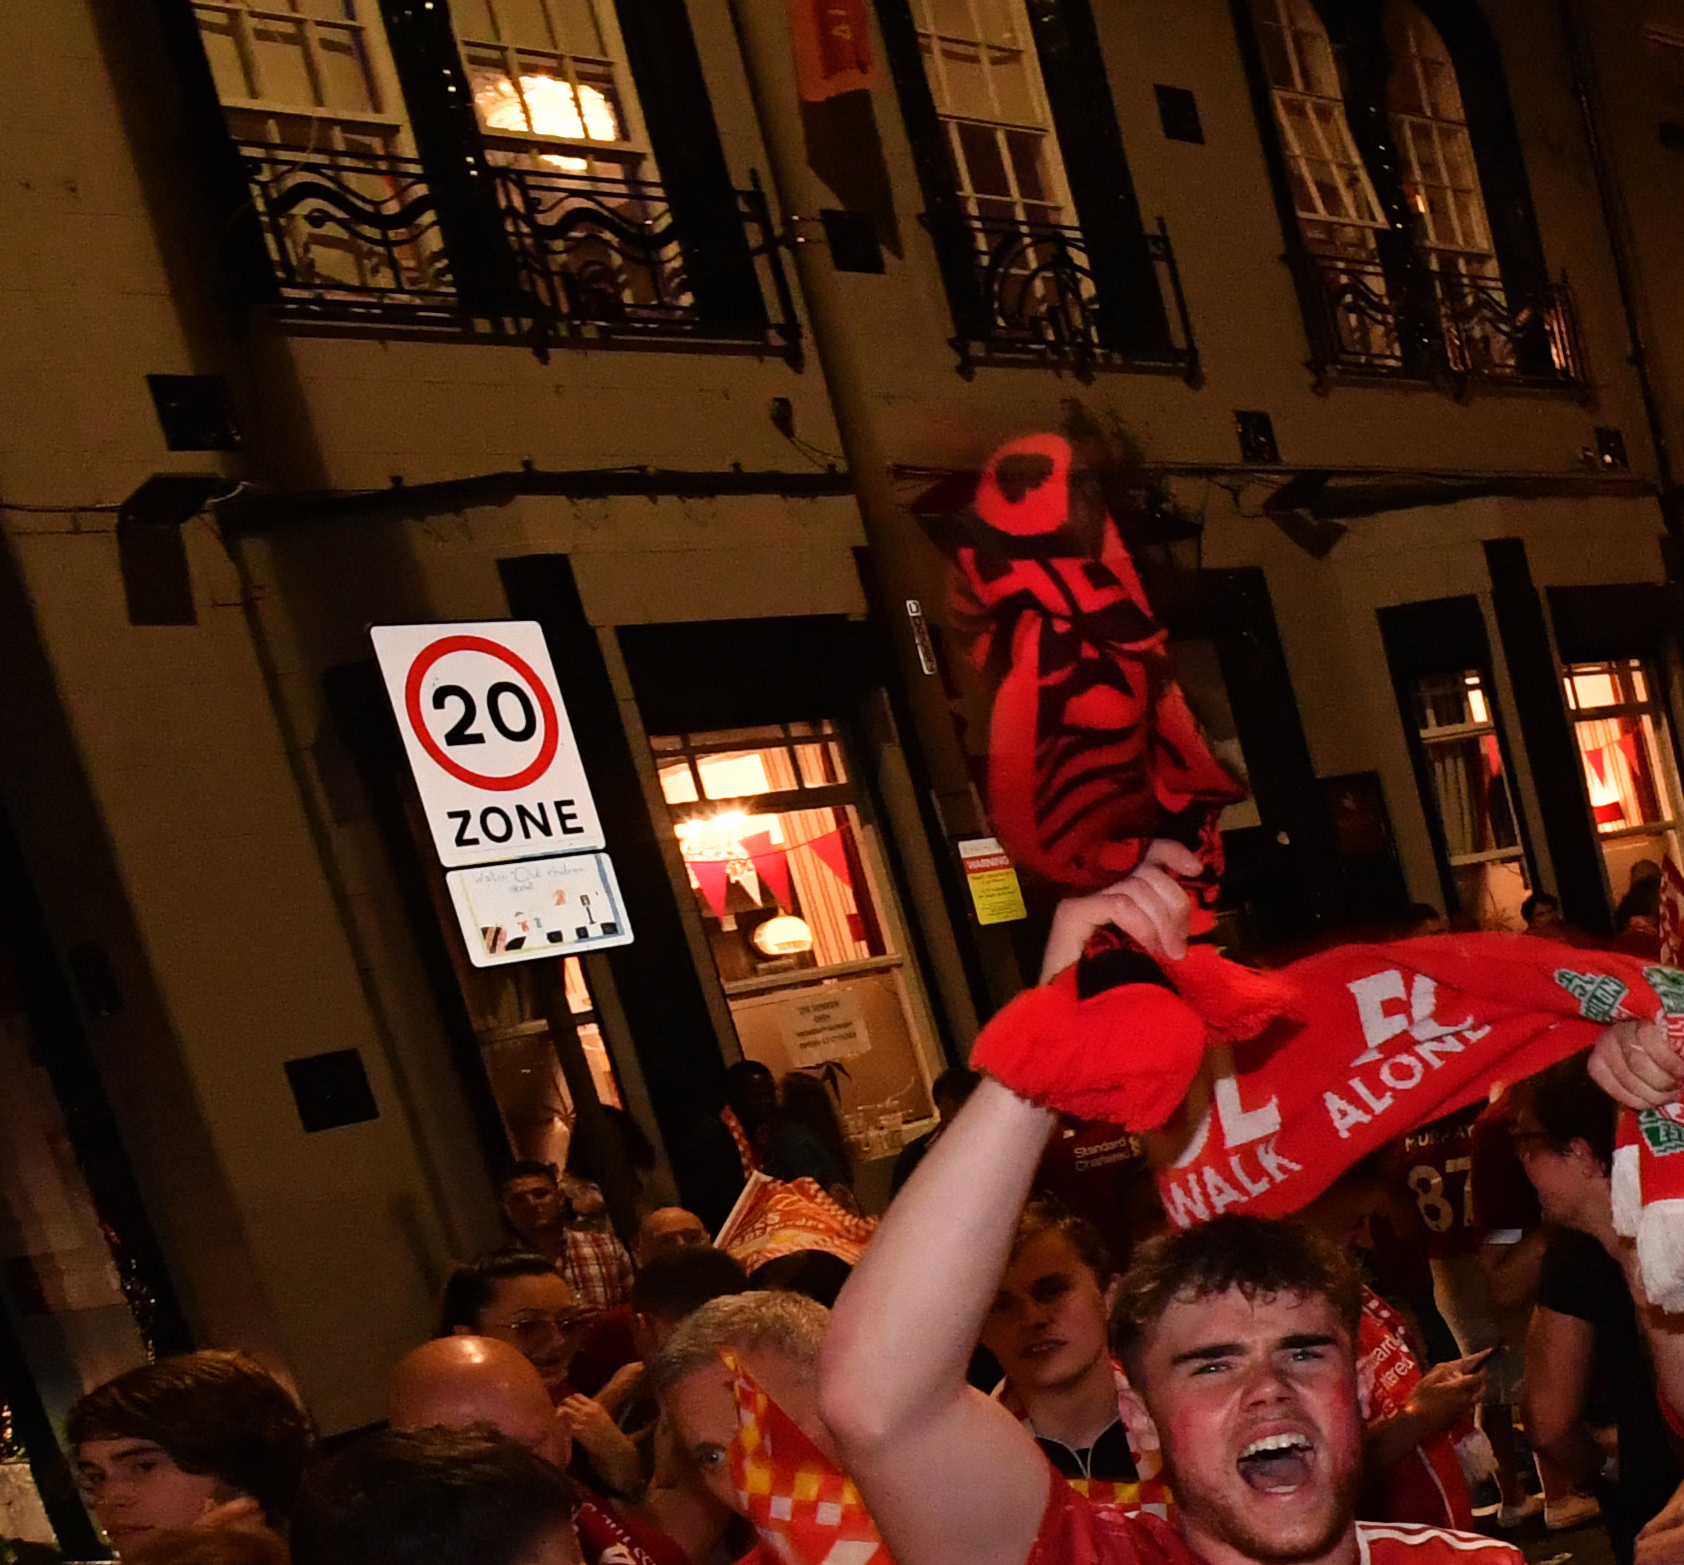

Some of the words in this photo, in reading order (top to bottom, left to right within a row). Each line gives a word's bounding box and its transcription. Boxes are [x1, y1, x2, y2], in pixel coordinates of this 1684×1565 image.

[432, 681, 536, 747] 20
[447, 799, 584, 848] ZONE
[1160, 1138, 1303, 1229] WALK
[1322, 1023, 1492, 1140] ALONE
[1407, 1156, 1474, 1232] 87
